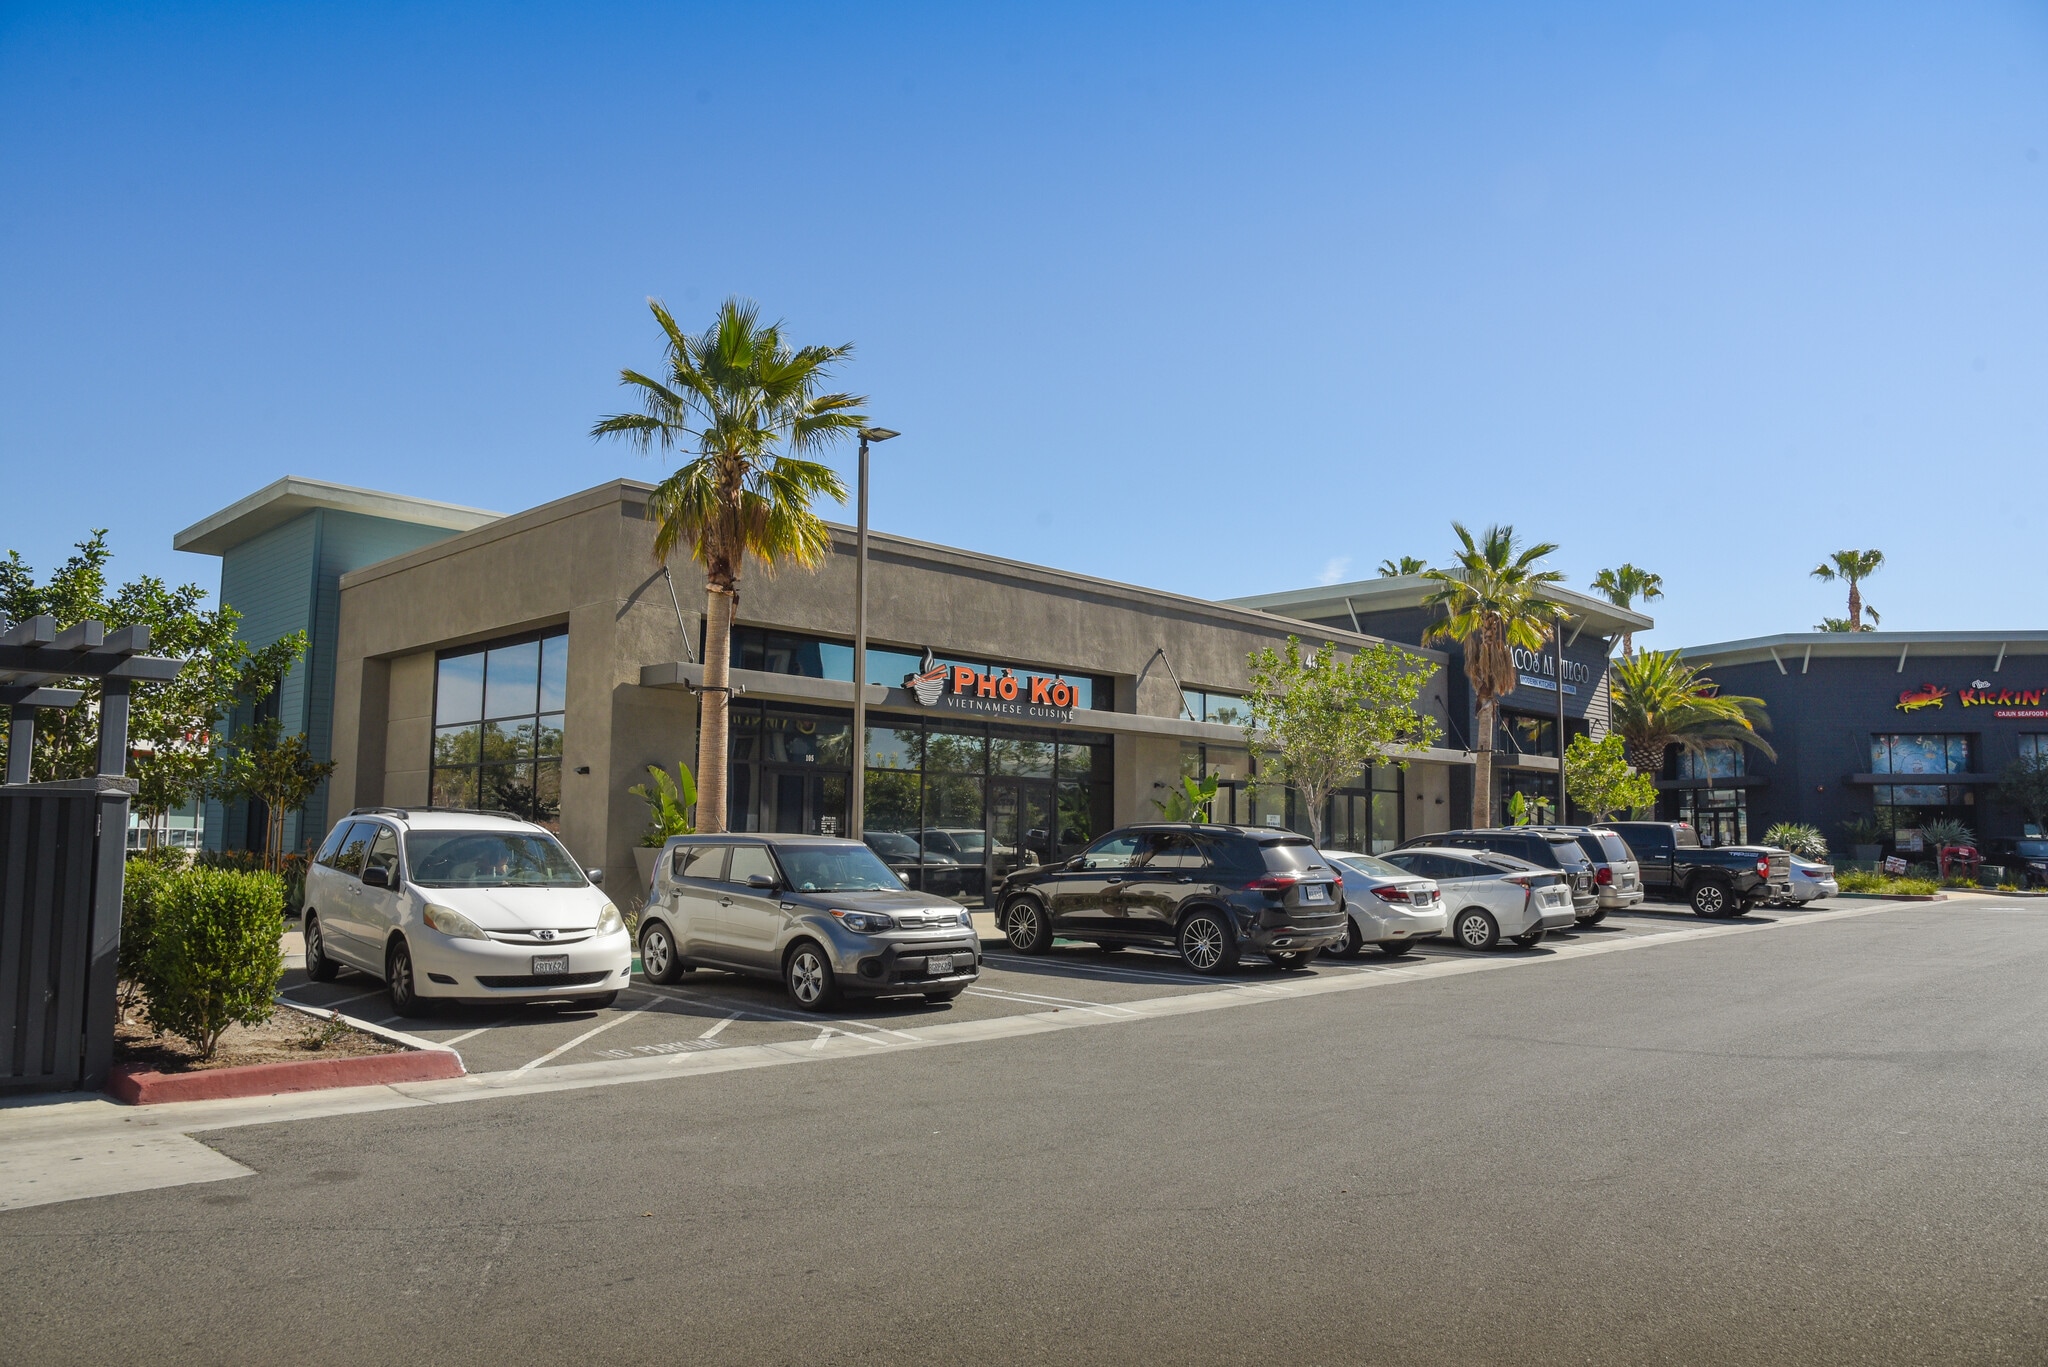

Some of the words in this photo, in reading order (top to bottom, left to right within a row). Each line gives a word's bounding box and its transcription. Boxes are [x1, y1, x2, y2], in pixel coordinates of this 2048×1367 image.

[1543, 654, 1555, 677] AL
[947, 698, 1022, 714] VIETNAMESE
[1029, 707, 1074, 720] CUISINE
